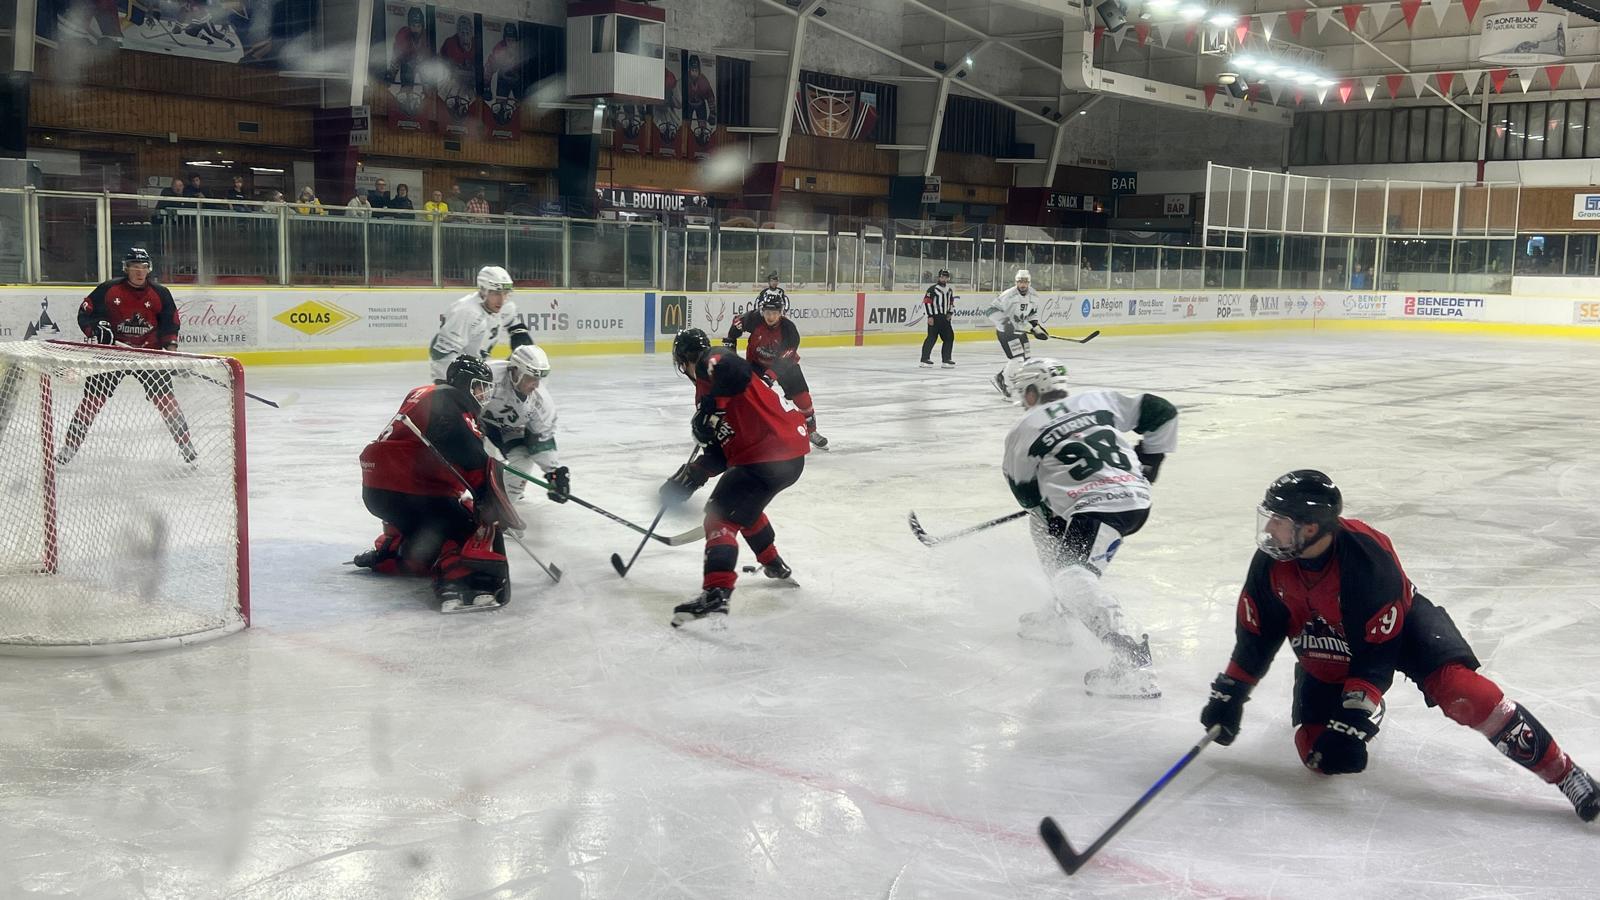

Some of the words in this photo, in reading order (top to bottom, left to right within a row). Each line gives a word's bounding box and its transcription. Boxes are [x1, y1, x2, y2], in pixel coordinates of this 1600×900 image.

[1112, 178, 1136, 190] BAR
[612, 190, 626, 207] LA
[633, 192, 686, 210] BOUTIQUE
[732, 302, 744, 314] Le
[1092, 298, 1100, 310] La
[1100, 298, 1123, 311] Région
[1418, 297, 1484, 308] BENEDETTI
[290, 312, 331, 324] COLAS
[868, 308, 907, 324] ATMB
[1217, 307, 1232, 318] POP
[1416, 308, 1463, 316] GUELPA
[576, 319, 624, 330] GROUPE
[178, 335, 208, 344] MONIX
[212, 334, 247, 344] ENTRE
[1041, 414, 1099, 447] STURNY
